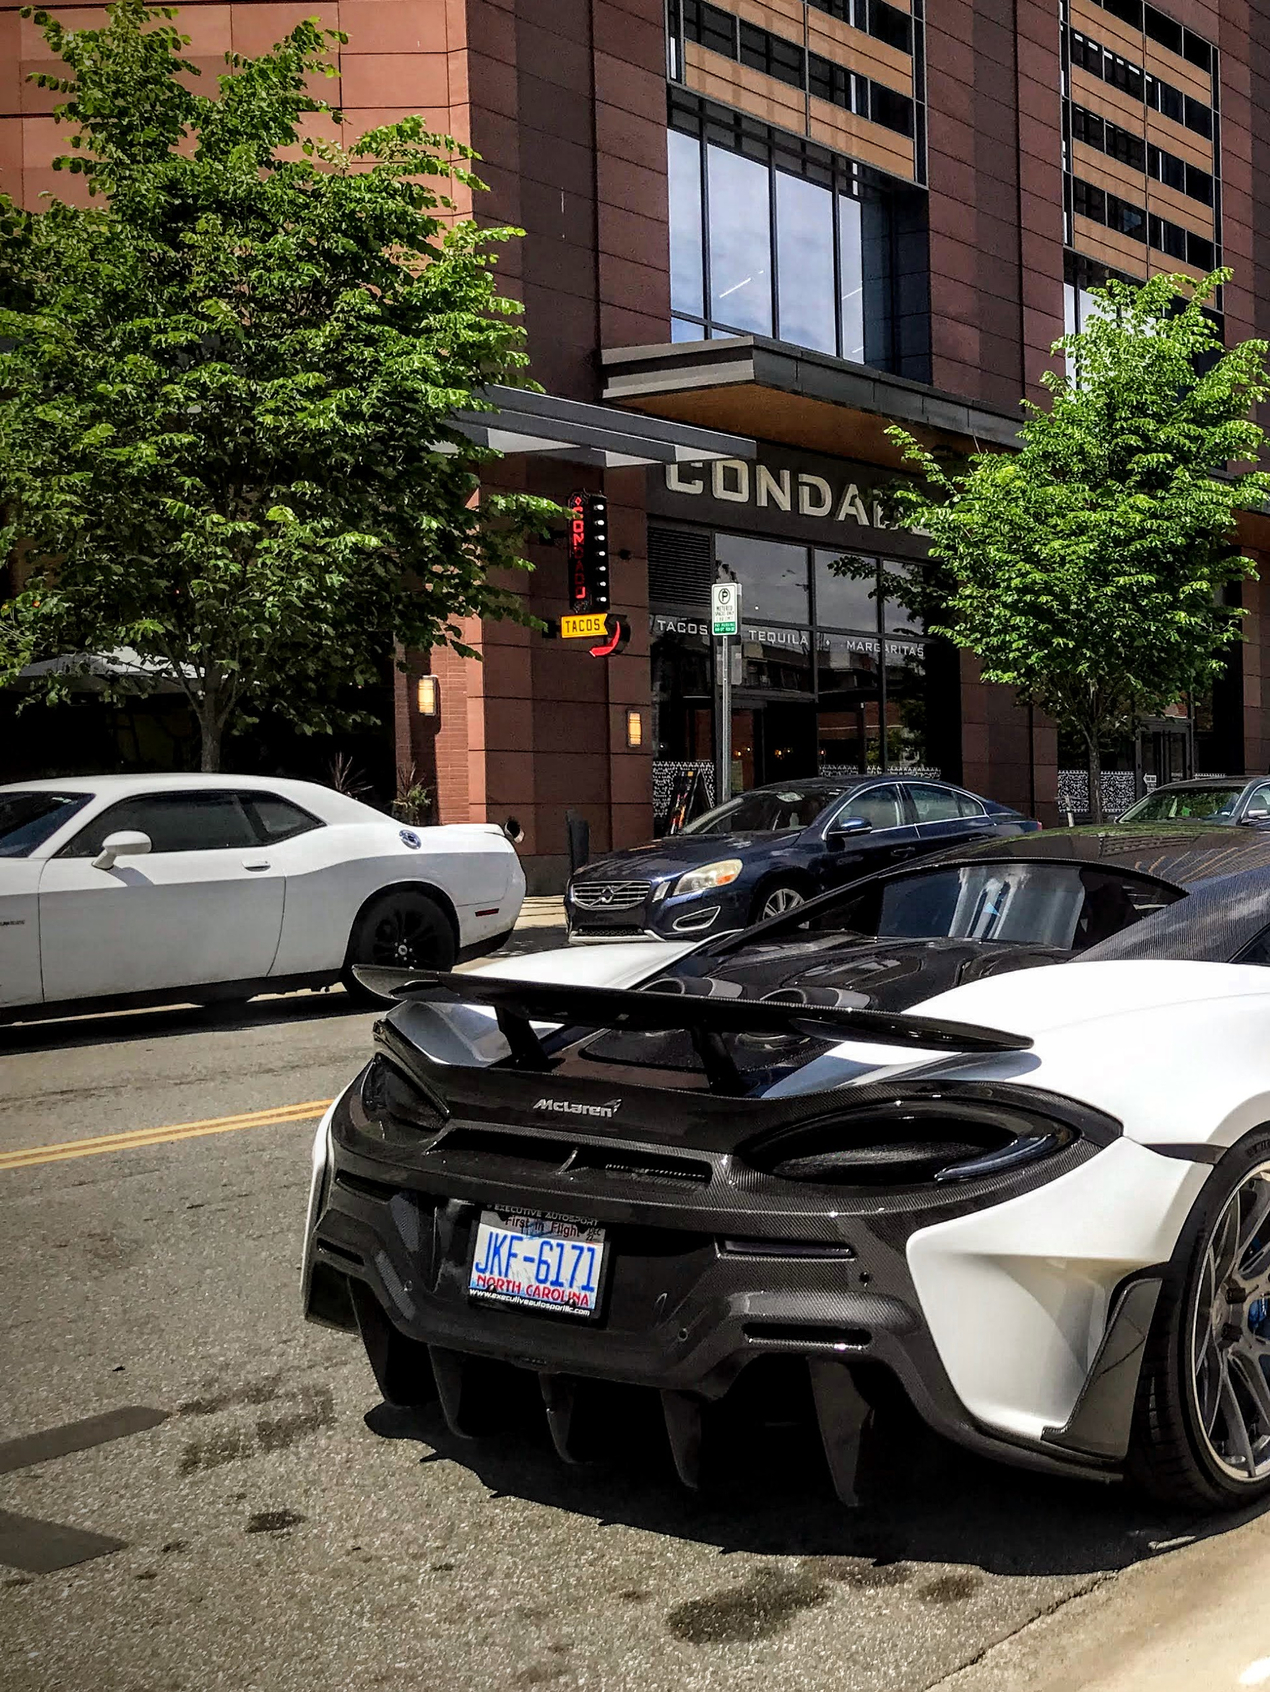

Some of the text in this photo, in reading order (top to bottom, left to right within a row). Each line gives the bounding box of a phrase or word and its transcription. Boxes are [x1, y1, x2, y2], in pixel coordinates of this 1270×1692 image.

[665, 458, 937, 538] CONDA
[565, 618, 601, 634] TACOS
[657, 619, 708, 636] TACOS
[749, 629, 809, 646] TEQUILA
[846, 641, 925, 658] MARGARITAS
[533, 1099, 612, 1117] McLaren
[494, 1204, 599, 1227] EXECUTIVE AUTOSPORT
[505, 1214, 529, 1229] First
[534, 1220, 544, 1231] in
[475, 1231, 596, 1292] JKF-6171
[476, 1274, 590, 1307] NORTH CAROLINA
